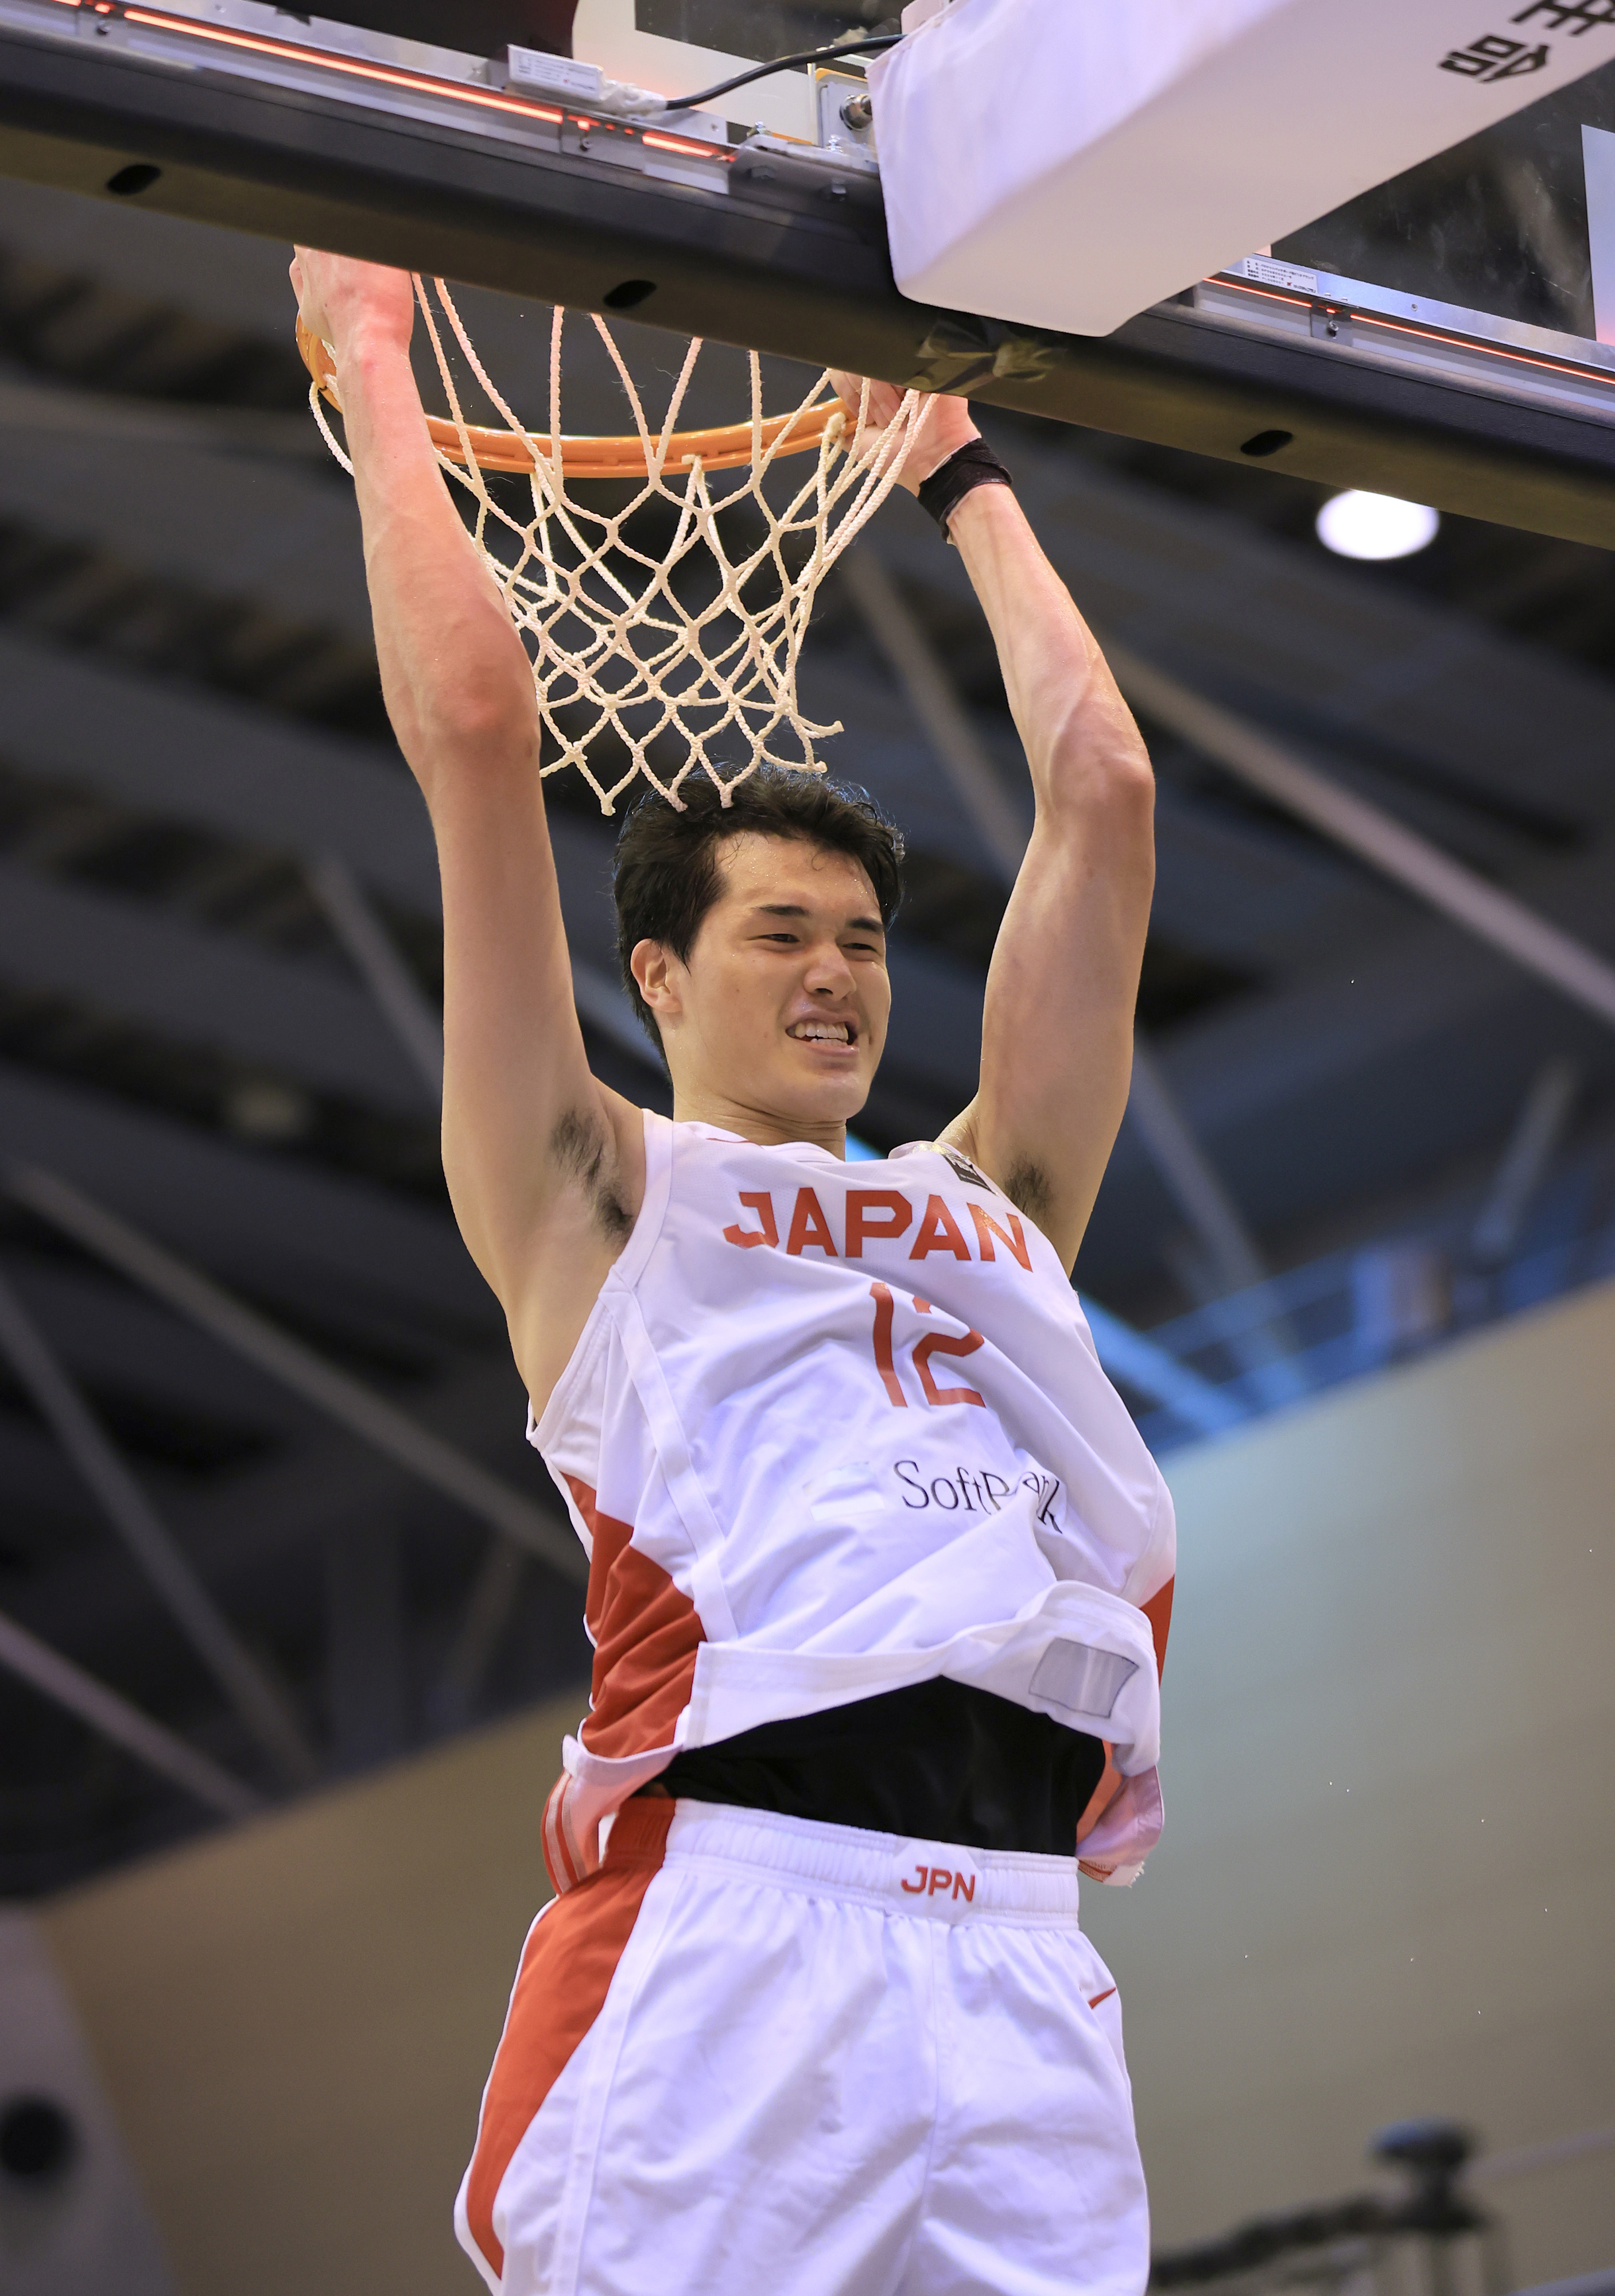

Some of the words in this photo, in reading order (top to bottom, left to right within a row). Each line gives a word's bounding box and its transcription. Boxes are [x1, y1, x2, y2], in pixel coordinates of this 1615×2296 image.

[723, 1187, 1033, 1273] JAPAN
[869, 1282, 986, 1408] 12
[901, 1865, 975, 1902] JPN
